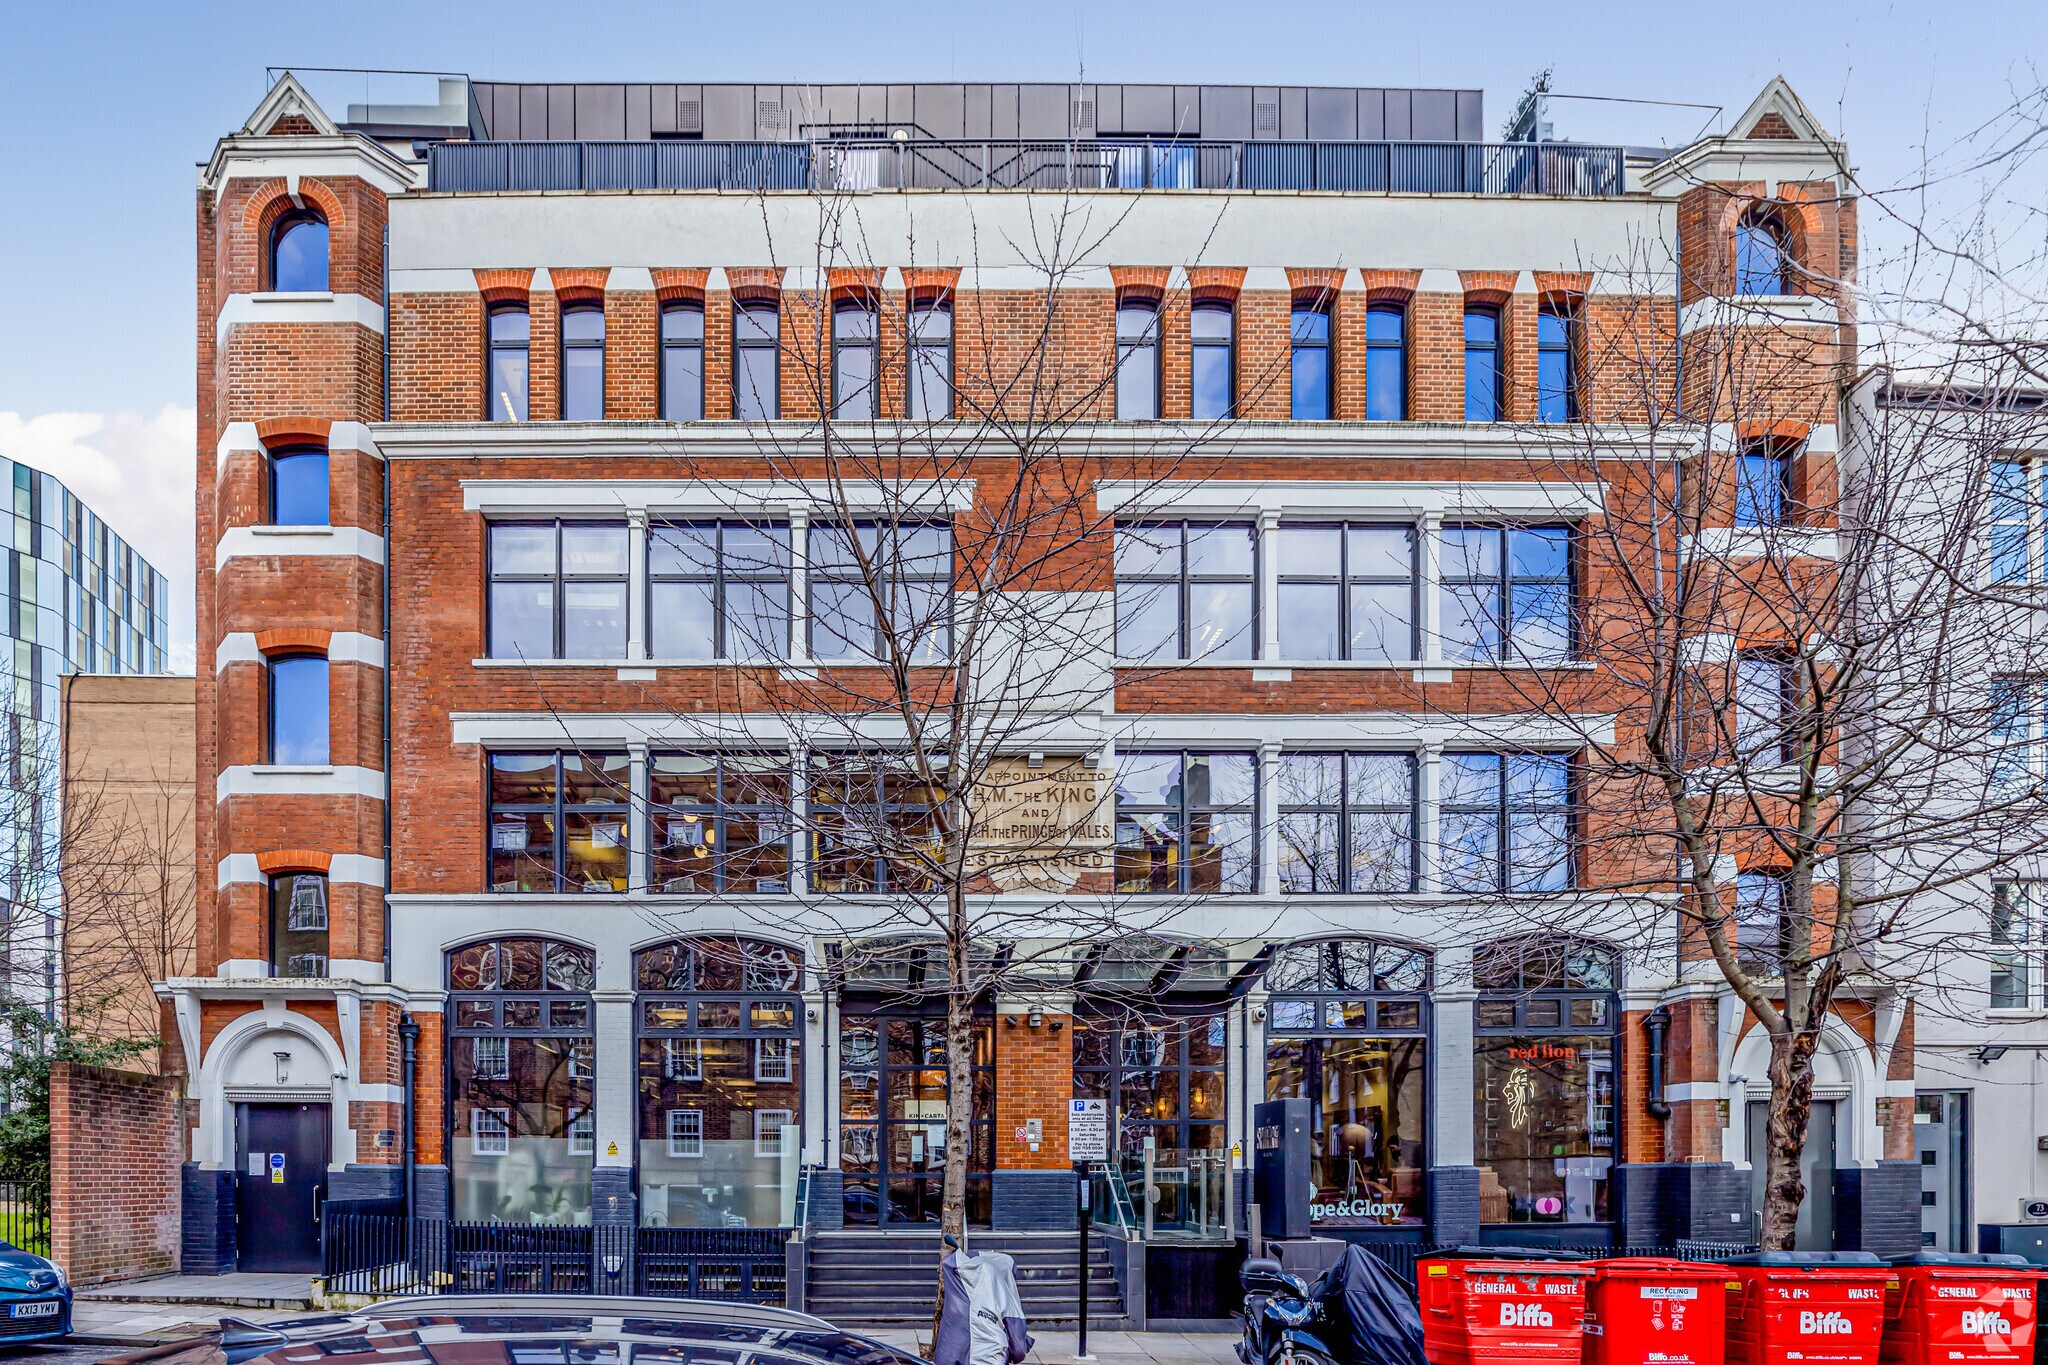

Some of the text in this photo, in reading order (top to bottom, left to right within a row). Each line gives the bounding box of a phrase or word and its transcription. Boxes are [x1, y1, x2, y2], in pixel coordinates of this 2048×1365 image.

[985, 772, 1106, 782] APPOINTMENT TO
[1013, 792, 1042, 803] THE
[1021, 809, 1050, 818] AND
[992, 828, 1010, 839] THE
[1011, 824, 1054, 839] PRINCE
[964, 855, 1104, 867] ESTABLISHED
[1509, 1044, 1575, 1059] red lion
[2035, 1203, 2045, 1212] 73
[1474, 1283, 1578, 1295] GENERAL WASTE
[1650, 1287, 1689, 1296] RECYCLING
[1938, 1287, 2032, 1299] GENERAL WASTE
[18, 1303, 56, 1316] KX13 YMV
[1500, 1303, 1553, 1327] Biffa
[1800, 1311, 1852, 1334] Biffa
[1962, 1311, 2011, 1334] Biffa
[1787, 1352, 1804, 1360] Biffa
[1948, 1351, 1965, 1360] Biffa
